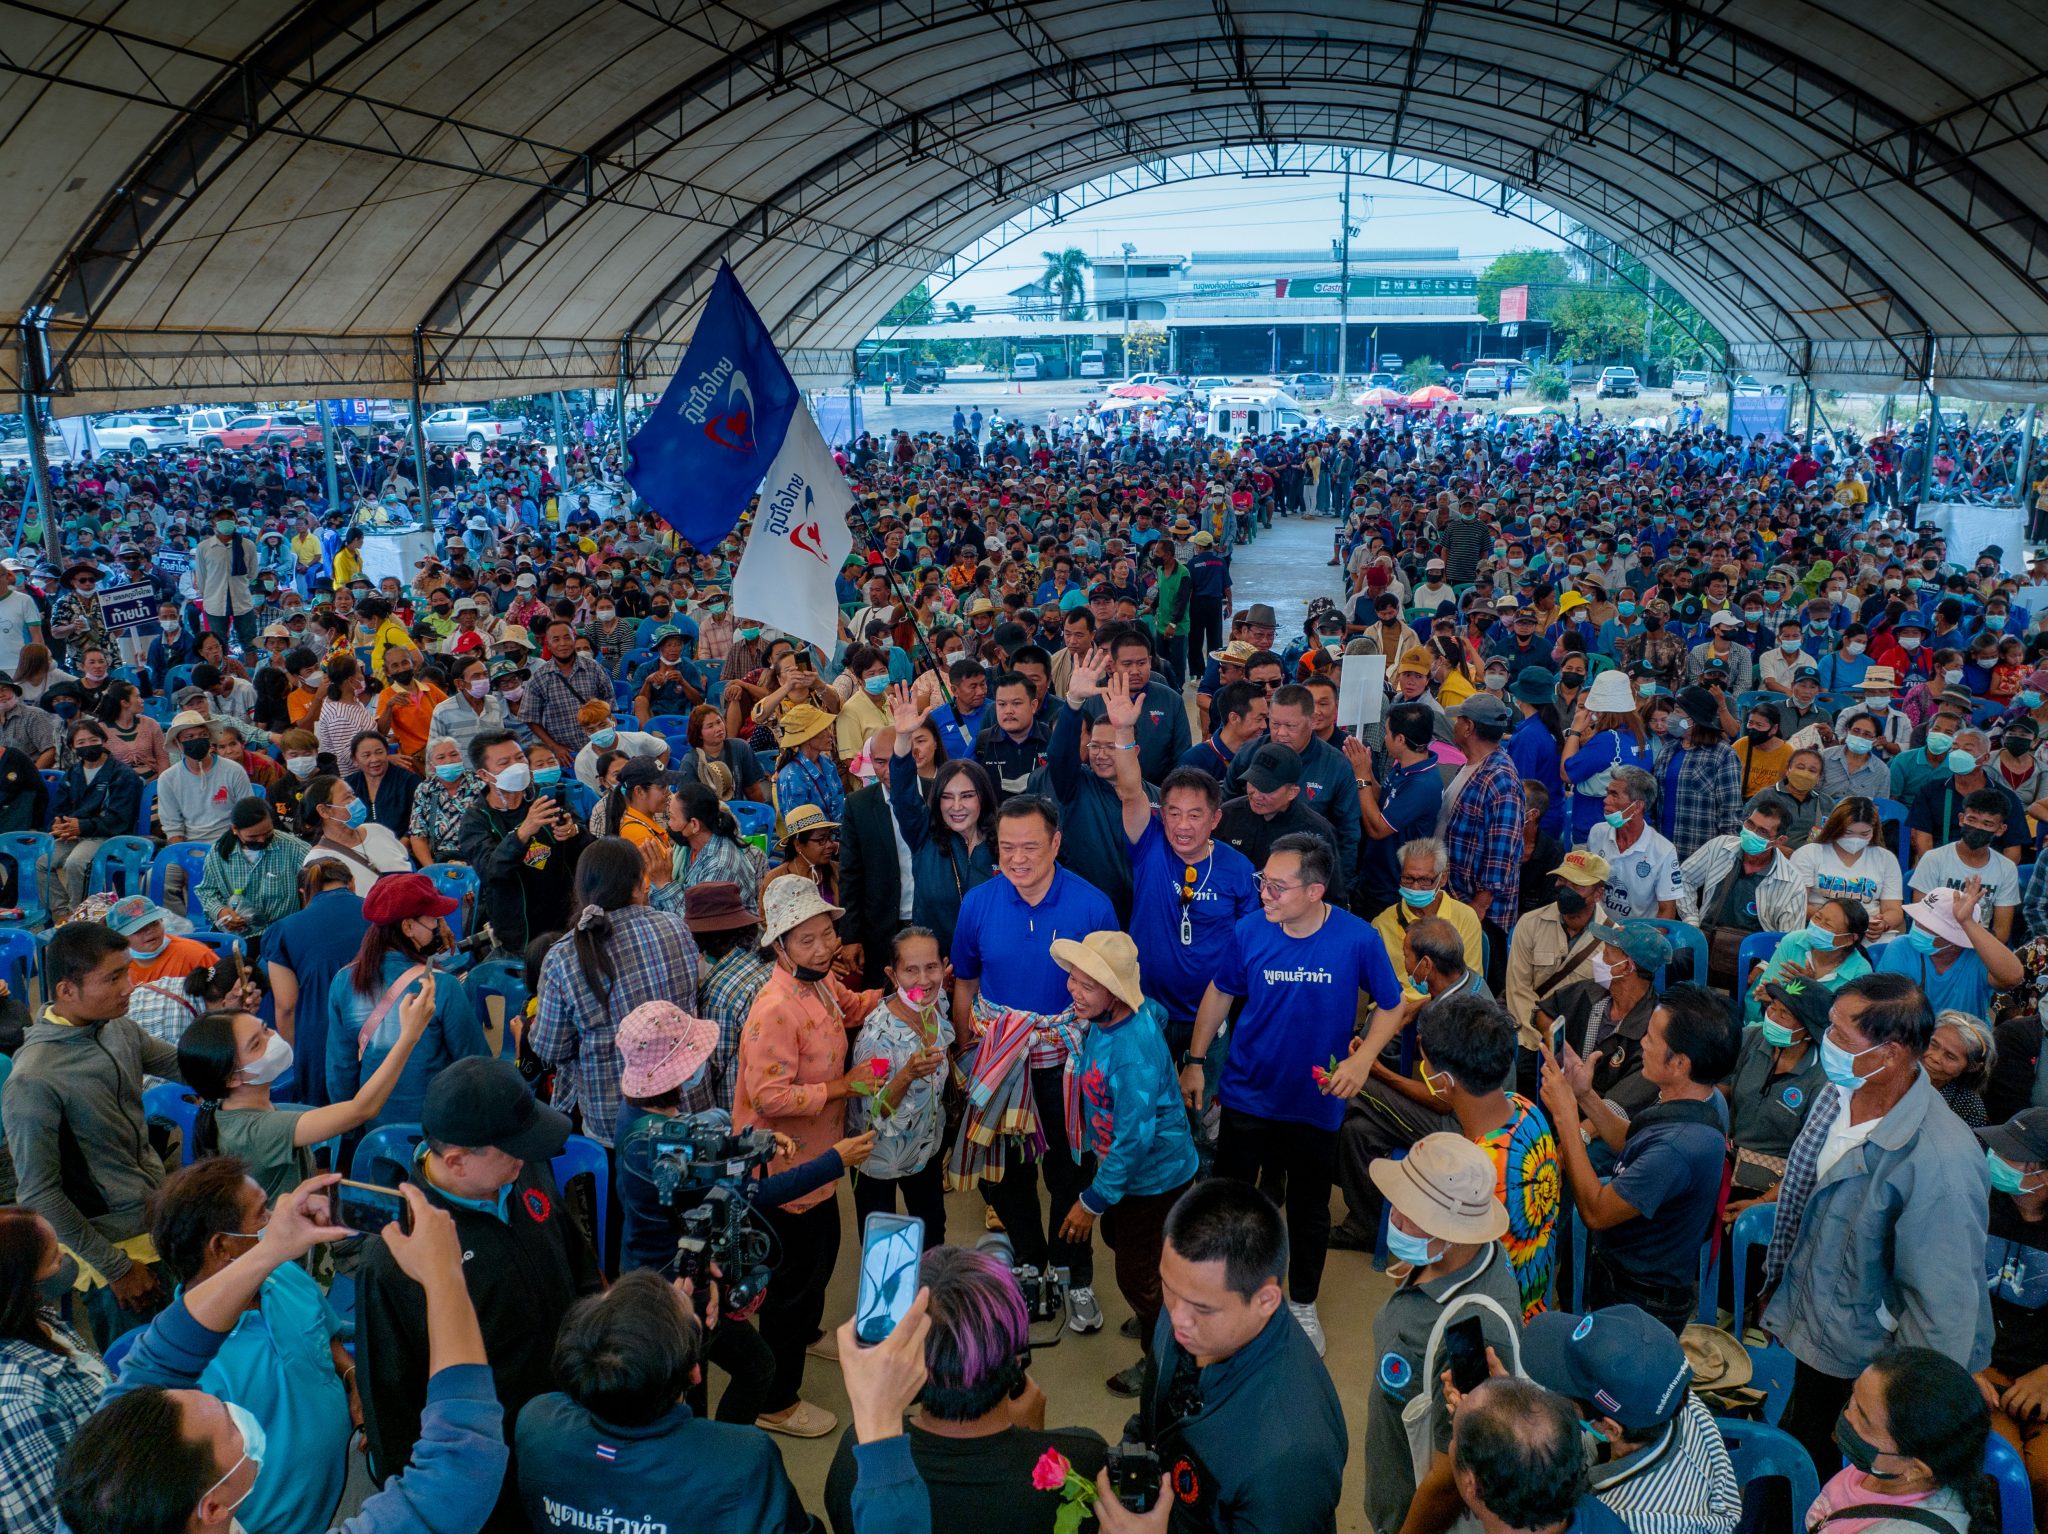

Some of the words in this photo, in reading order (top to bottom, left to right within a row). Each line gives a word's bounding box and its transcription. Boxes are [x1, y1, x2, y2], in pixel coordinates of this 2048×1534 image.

[685, 356, 734, 425] ภูมิใจไทย
[356, 401, 365, 413] 5
[1231, 410, 1248, 419] EMS
[769, 472, 804, 537] ภูมิใจไทย
[111, 599, 151, 624] ท้ายน้ำ
[1263, 966, 1332, 986] พูดแล้วทำ
[542, 1495, 667, 1534] พูดแล้วทำ
